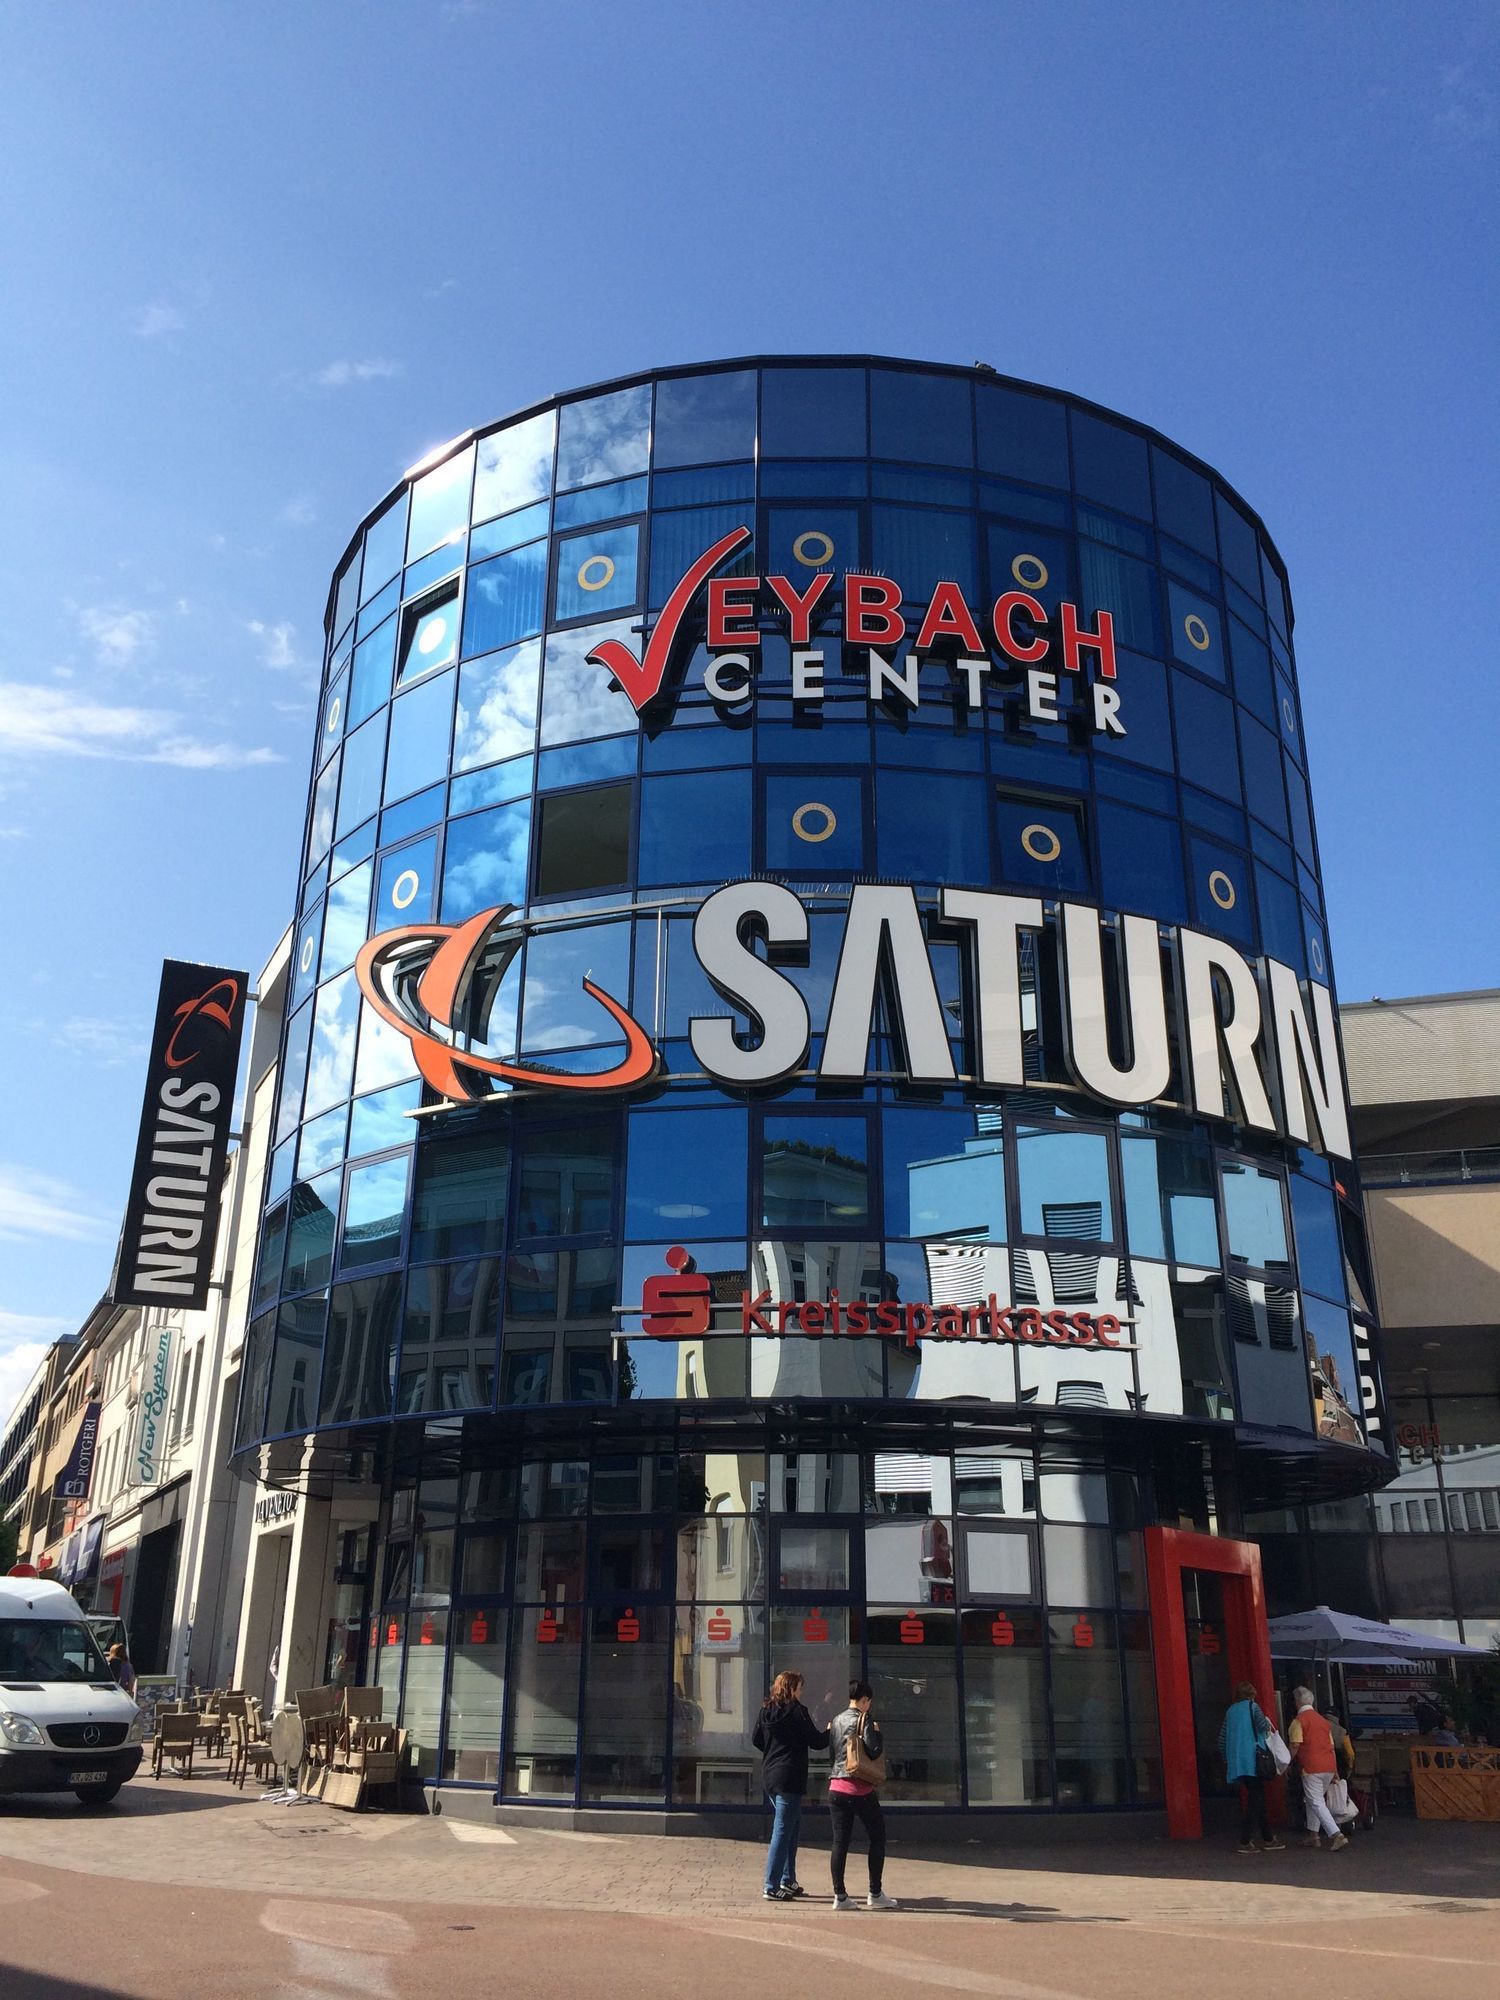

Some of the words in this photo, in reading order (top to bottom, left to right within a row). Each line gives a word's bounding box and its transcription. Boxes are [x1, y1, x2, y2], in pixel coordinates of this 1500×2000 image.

[704, 649, 1127, 737] CENTER
[690, 880, 1352, 1161] SATURN
[133, 1077, 221, 1296] SATURN
[742, 1289, 1121, 1346] Kreissparkasse
[144, 1332, 172, 1416] System
[78, 1418, 97, 1476] ROTGERI
[138, 1412, 156, 1482] New
